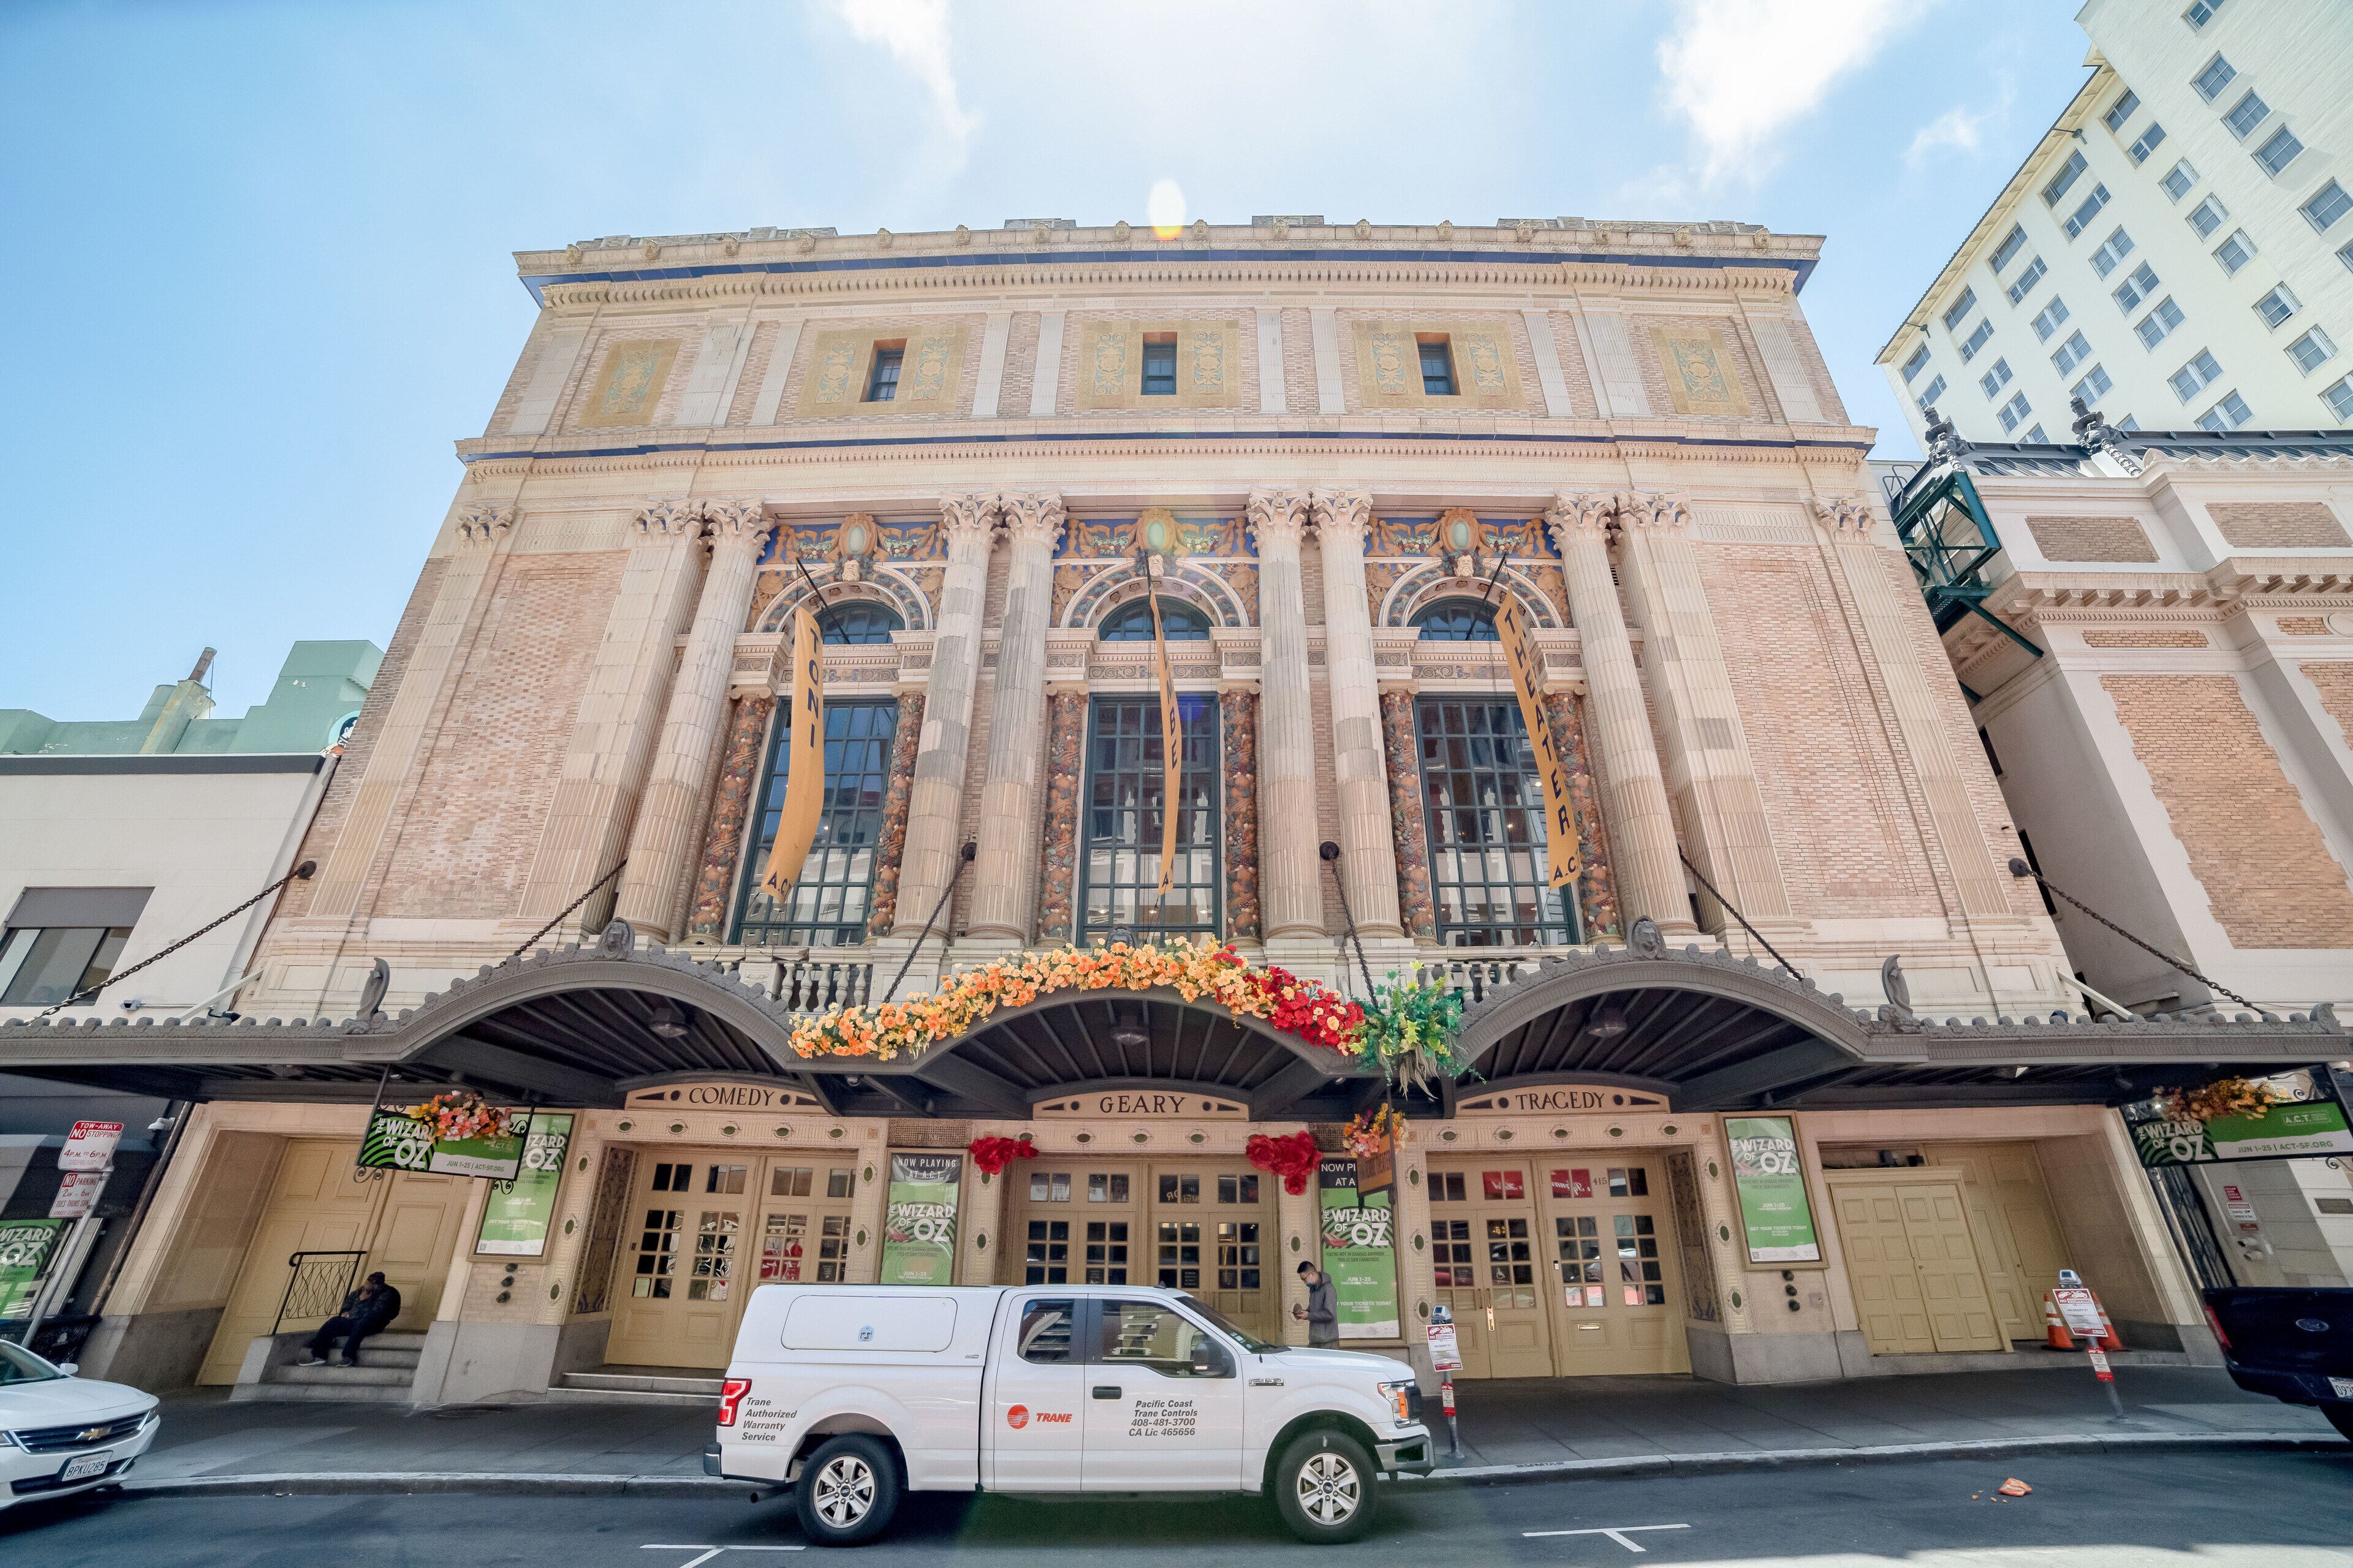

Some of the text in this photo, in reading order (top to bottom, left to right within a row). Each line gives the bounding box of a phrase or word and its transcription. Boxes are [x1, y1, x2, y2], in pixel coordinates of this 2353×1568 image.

[807, 627, 820, 749] TONI
[1504, 608, 1570, 836] THEATER
[689, 1087, 775, 1106] COMEDY
[1099, 1094, 1186, 1113] GEARY
[1515, 1091, 1605, 1110] TRAGEDY
[375, 1118, 386, 1134] THE
[386, 1119, 433, 1140] WIZAR
[2145, 1121, 2203, 1138] WIZARD
[71, 1129, 86, 1138] NO
[382, 1137, 398, 1147] OF
[526, 1135, 566, 1148] IZARD
[1739, 1138, 1793, 1151] WIZARD
[2152, 1139, 2165, 1149] OF
[2169, 1135, 2213, 1161] OZ
[2279, 1140, 2334, 1151] ACT-SF.ORG
[395, 1139, 433, 1168] OZ
[526, 1148, 561, 1170] OZ
[474, 1162, 505, 1172] ACT-SF.ORG
[898, 1158, 957, 1167] NOW PLAYING
[1760, 1151, 1796, 1173] OZ
[64, 1175, 98, 1186] NO PARKING
[898, 1204, 954, 1218] WIZARD
[1332, 1208, 1390, 1222] WIZARD
[914, 1218, 950, 1242] OZ
[1335, 1223, 1347, 1232] OF
[1351, 1222, 1389, 1246] OZ
[1, 1242, 46, 1266] OZ
[747, 1397, 771, 1406] Trane
[745, 1409, 797, 1418] Authorized
[1036, 1412, 1073, 1423] TRANE
[743, 1420, 786, 1431] Warranty
[1131, 1418, 1195, 1426] 408-481-3700
[741, 1432, 776, 1441] Service
[66, 1460, 106, 1477] 8PKU285
